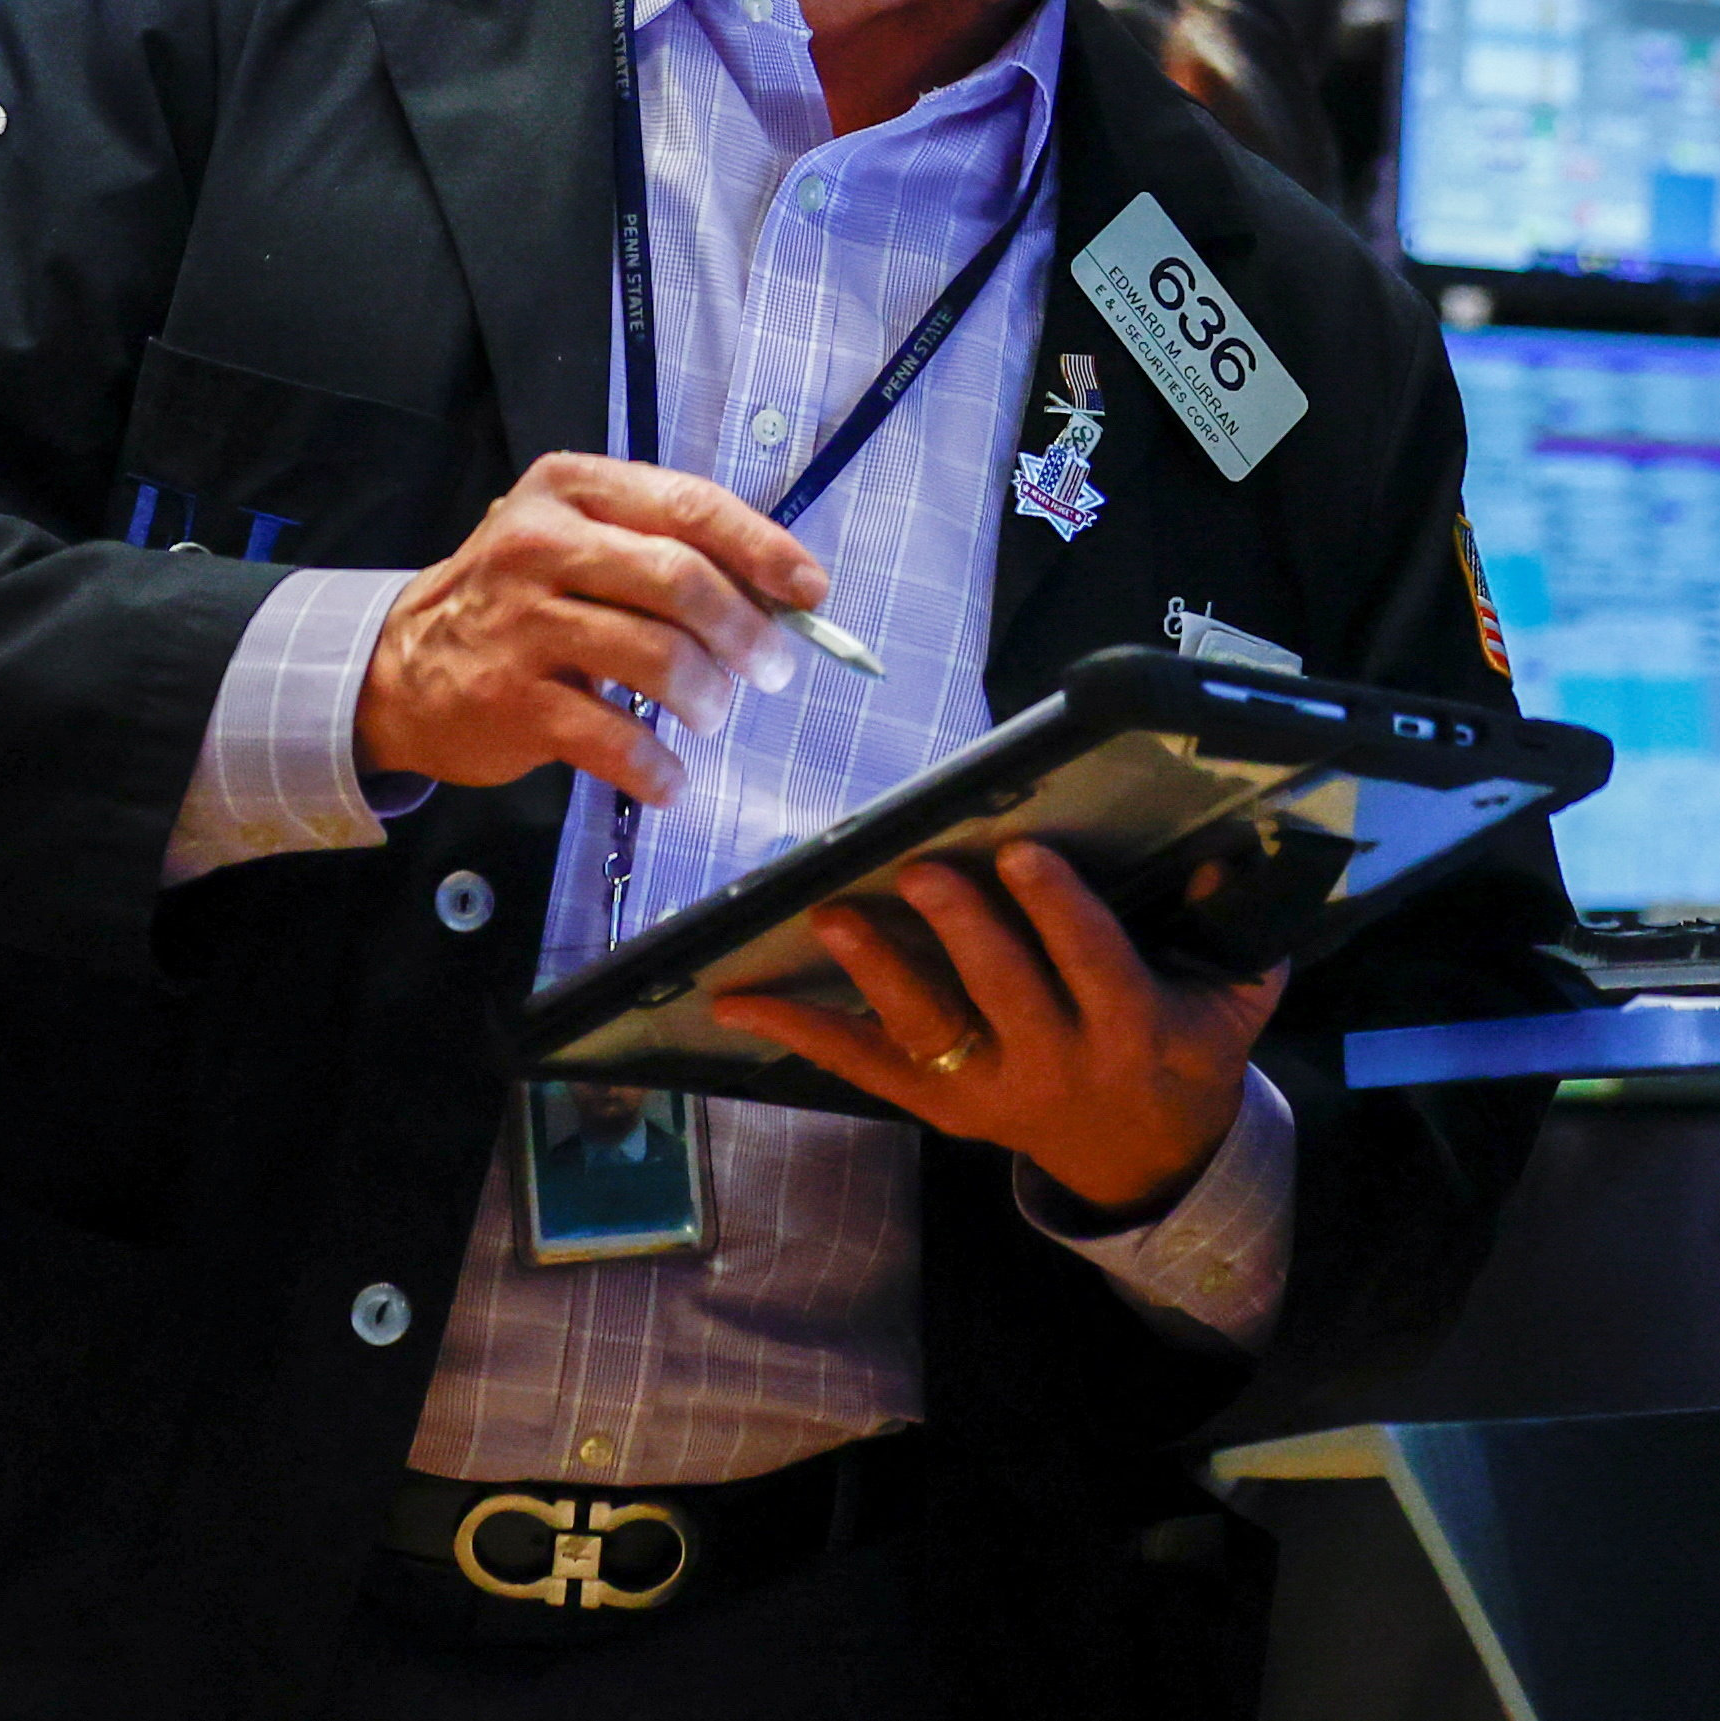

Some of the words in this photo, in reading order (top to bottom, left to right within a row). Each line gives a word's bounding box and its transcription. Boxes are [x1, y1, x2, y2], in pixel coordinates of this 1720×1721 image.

[623, 214, 641, 268] PENN
[626, 273, 645, 332] STATE
[1095, 283, 1108, 297] E
[1105, 298, 1116, 311] &
[1116, 314, 1127, 323] J
[1125, 324, 1188, 403] SECURITIES
[1149, 256, 1257, 392] 636
[881, 353, 920, 401] PENN
[1108, 265, 1166, 339] EDWARD
[1165, 340, 1182, 364] M.
[1184, 365, 1240, 436] CURRAN
